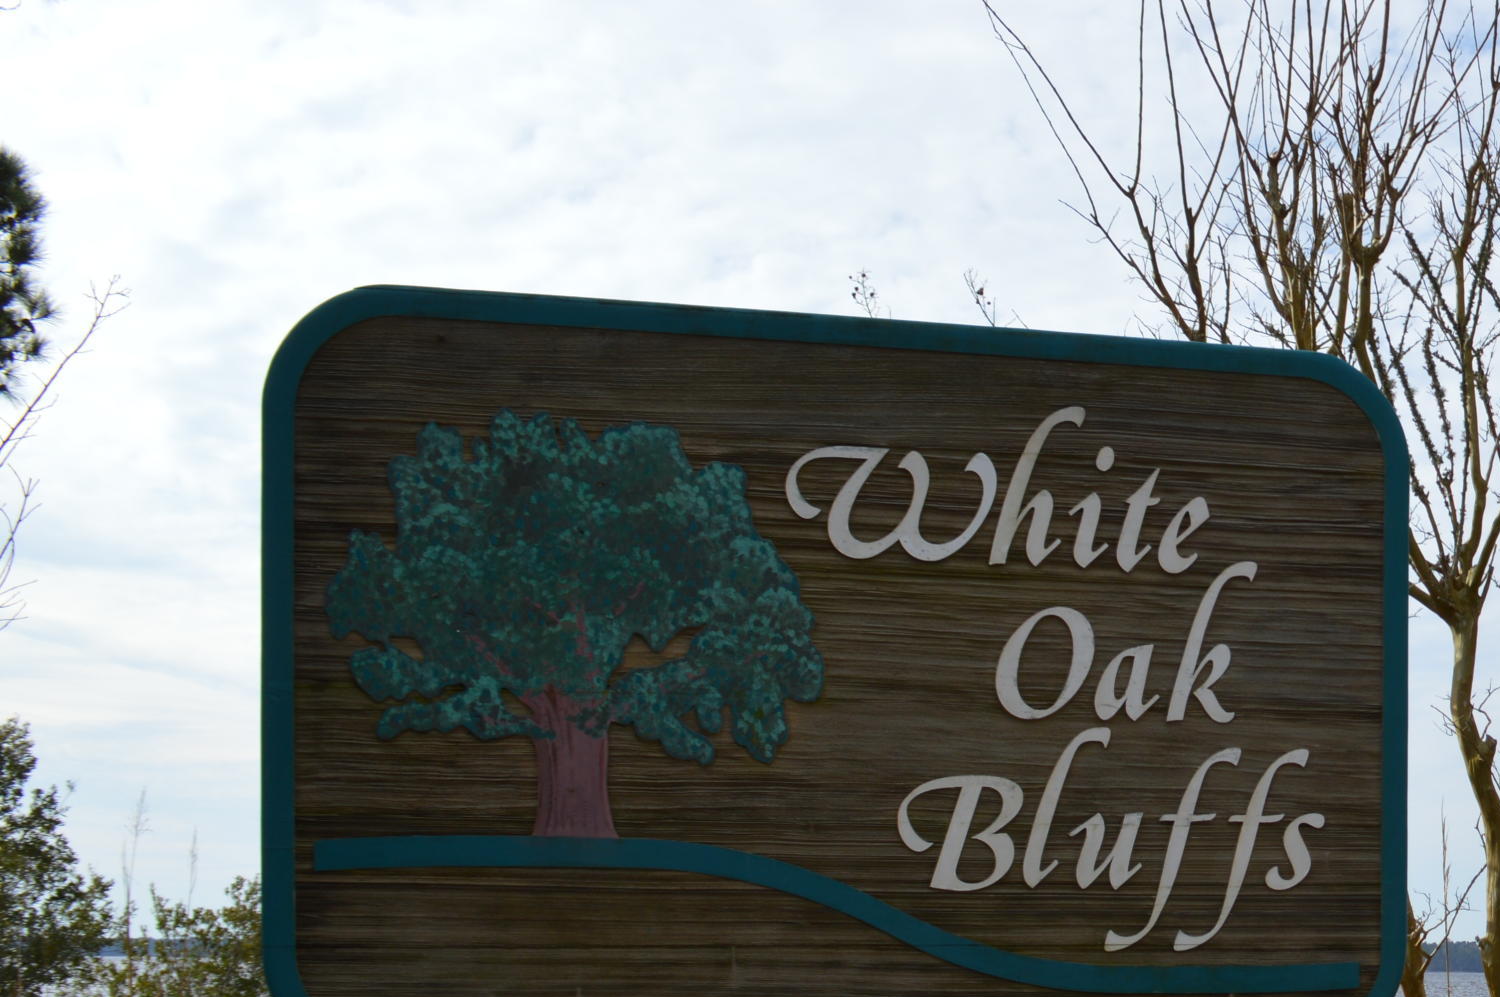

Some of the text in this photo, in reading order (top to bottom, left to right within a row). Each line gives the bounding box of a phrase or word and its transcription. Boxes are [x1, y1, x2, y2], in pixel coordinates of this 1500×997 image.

[785, 406, 1211, 574] White
[995, 561, 1257, 723] Oak
[897, 727, 1326, 951] Bluffs
